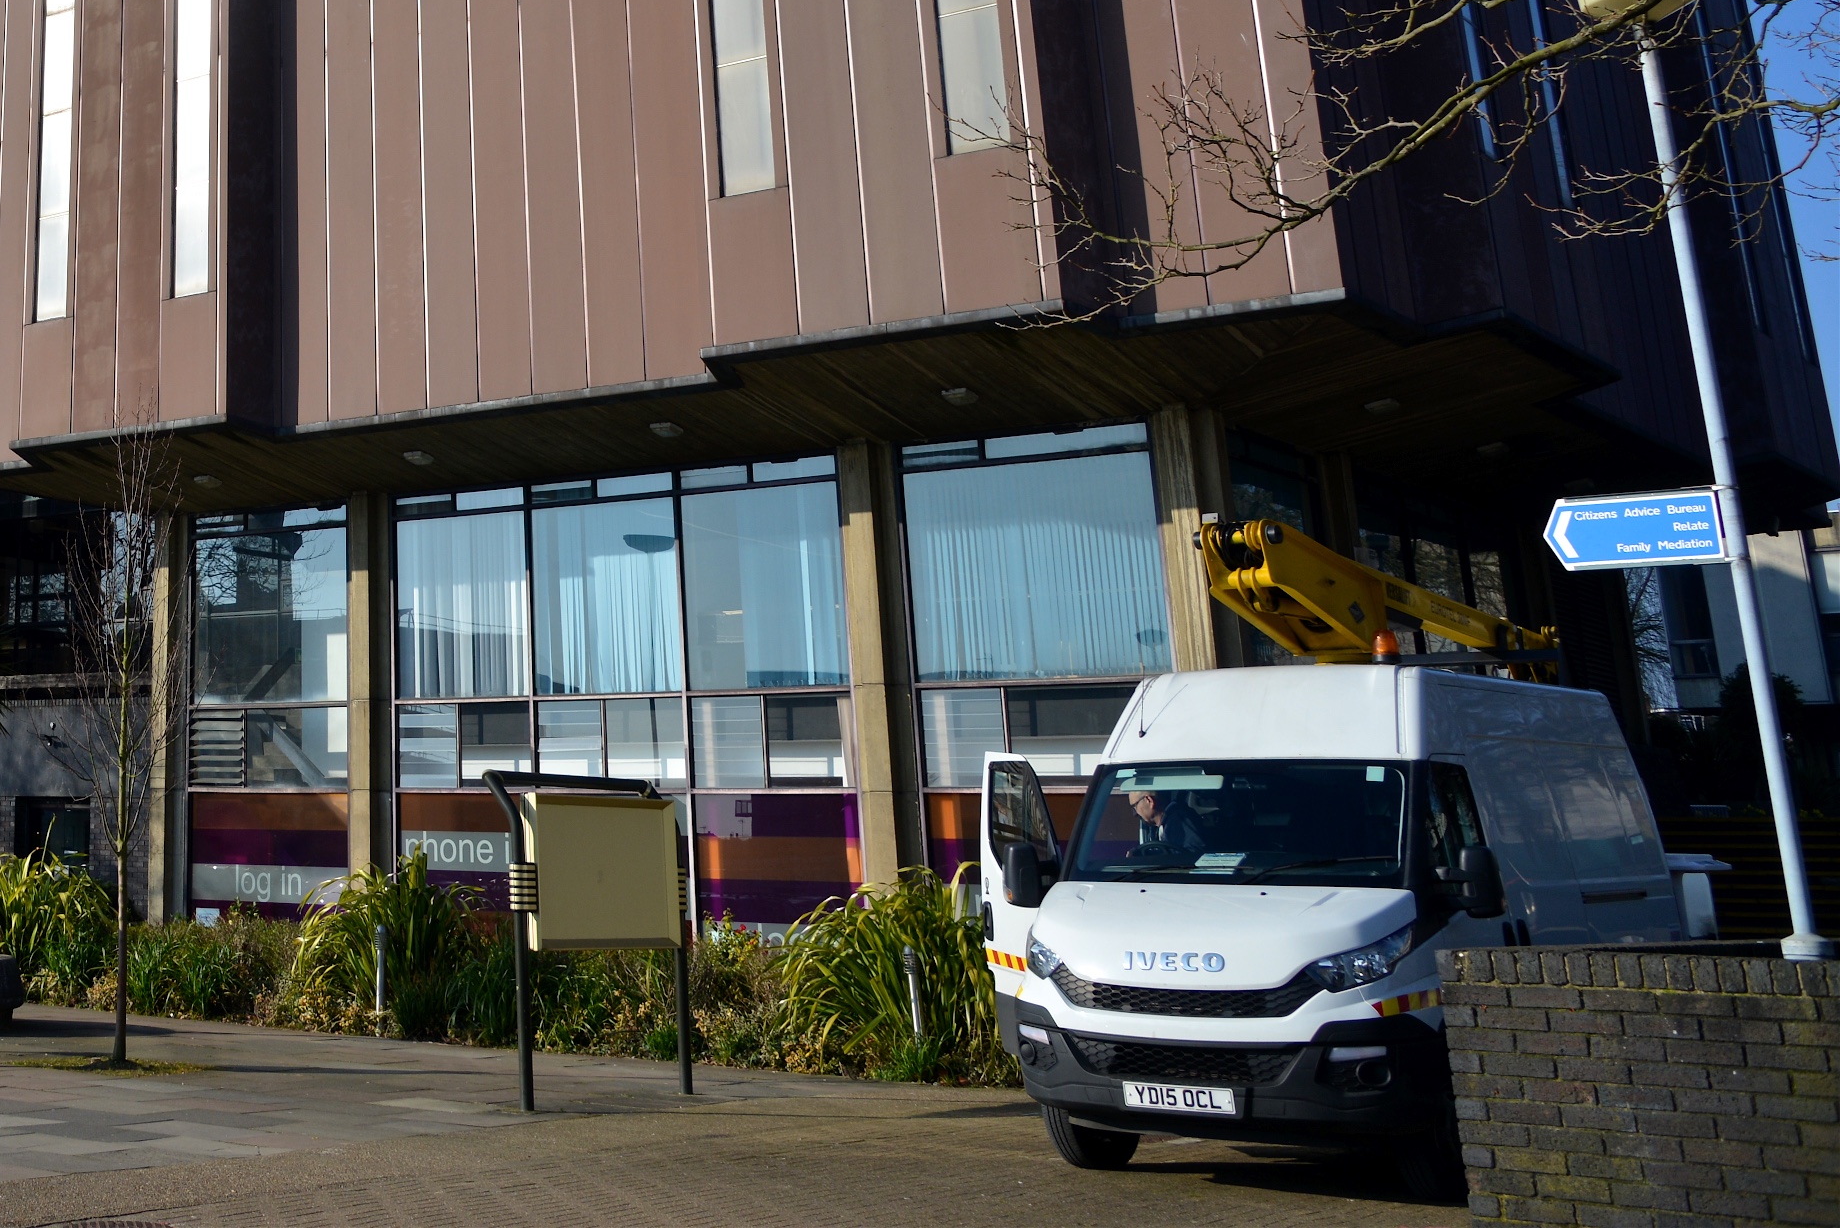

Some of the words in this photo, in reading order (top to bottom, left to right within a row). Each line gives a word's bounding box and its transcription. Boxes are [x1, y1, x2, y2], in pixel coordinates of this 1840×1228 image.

[1574, 511, 1618, 521] Citizens
[1624, 506, 1660, 518] Advice
[1666, 504, 1706, 515] Bureau
[1673, 521, 1709, 532] Relate
[1616, 542, 1651, 553] Family
[1657, 538, 1713, 550] Mediation
[235, 864, 271, 902] log
[281, 865, 302, 895] in
[1123, 951, 1226, 972] IVECO
[1135, 1085, 1177, 1106] YD15
[1182, 1089, 1222, 1110] OCL
